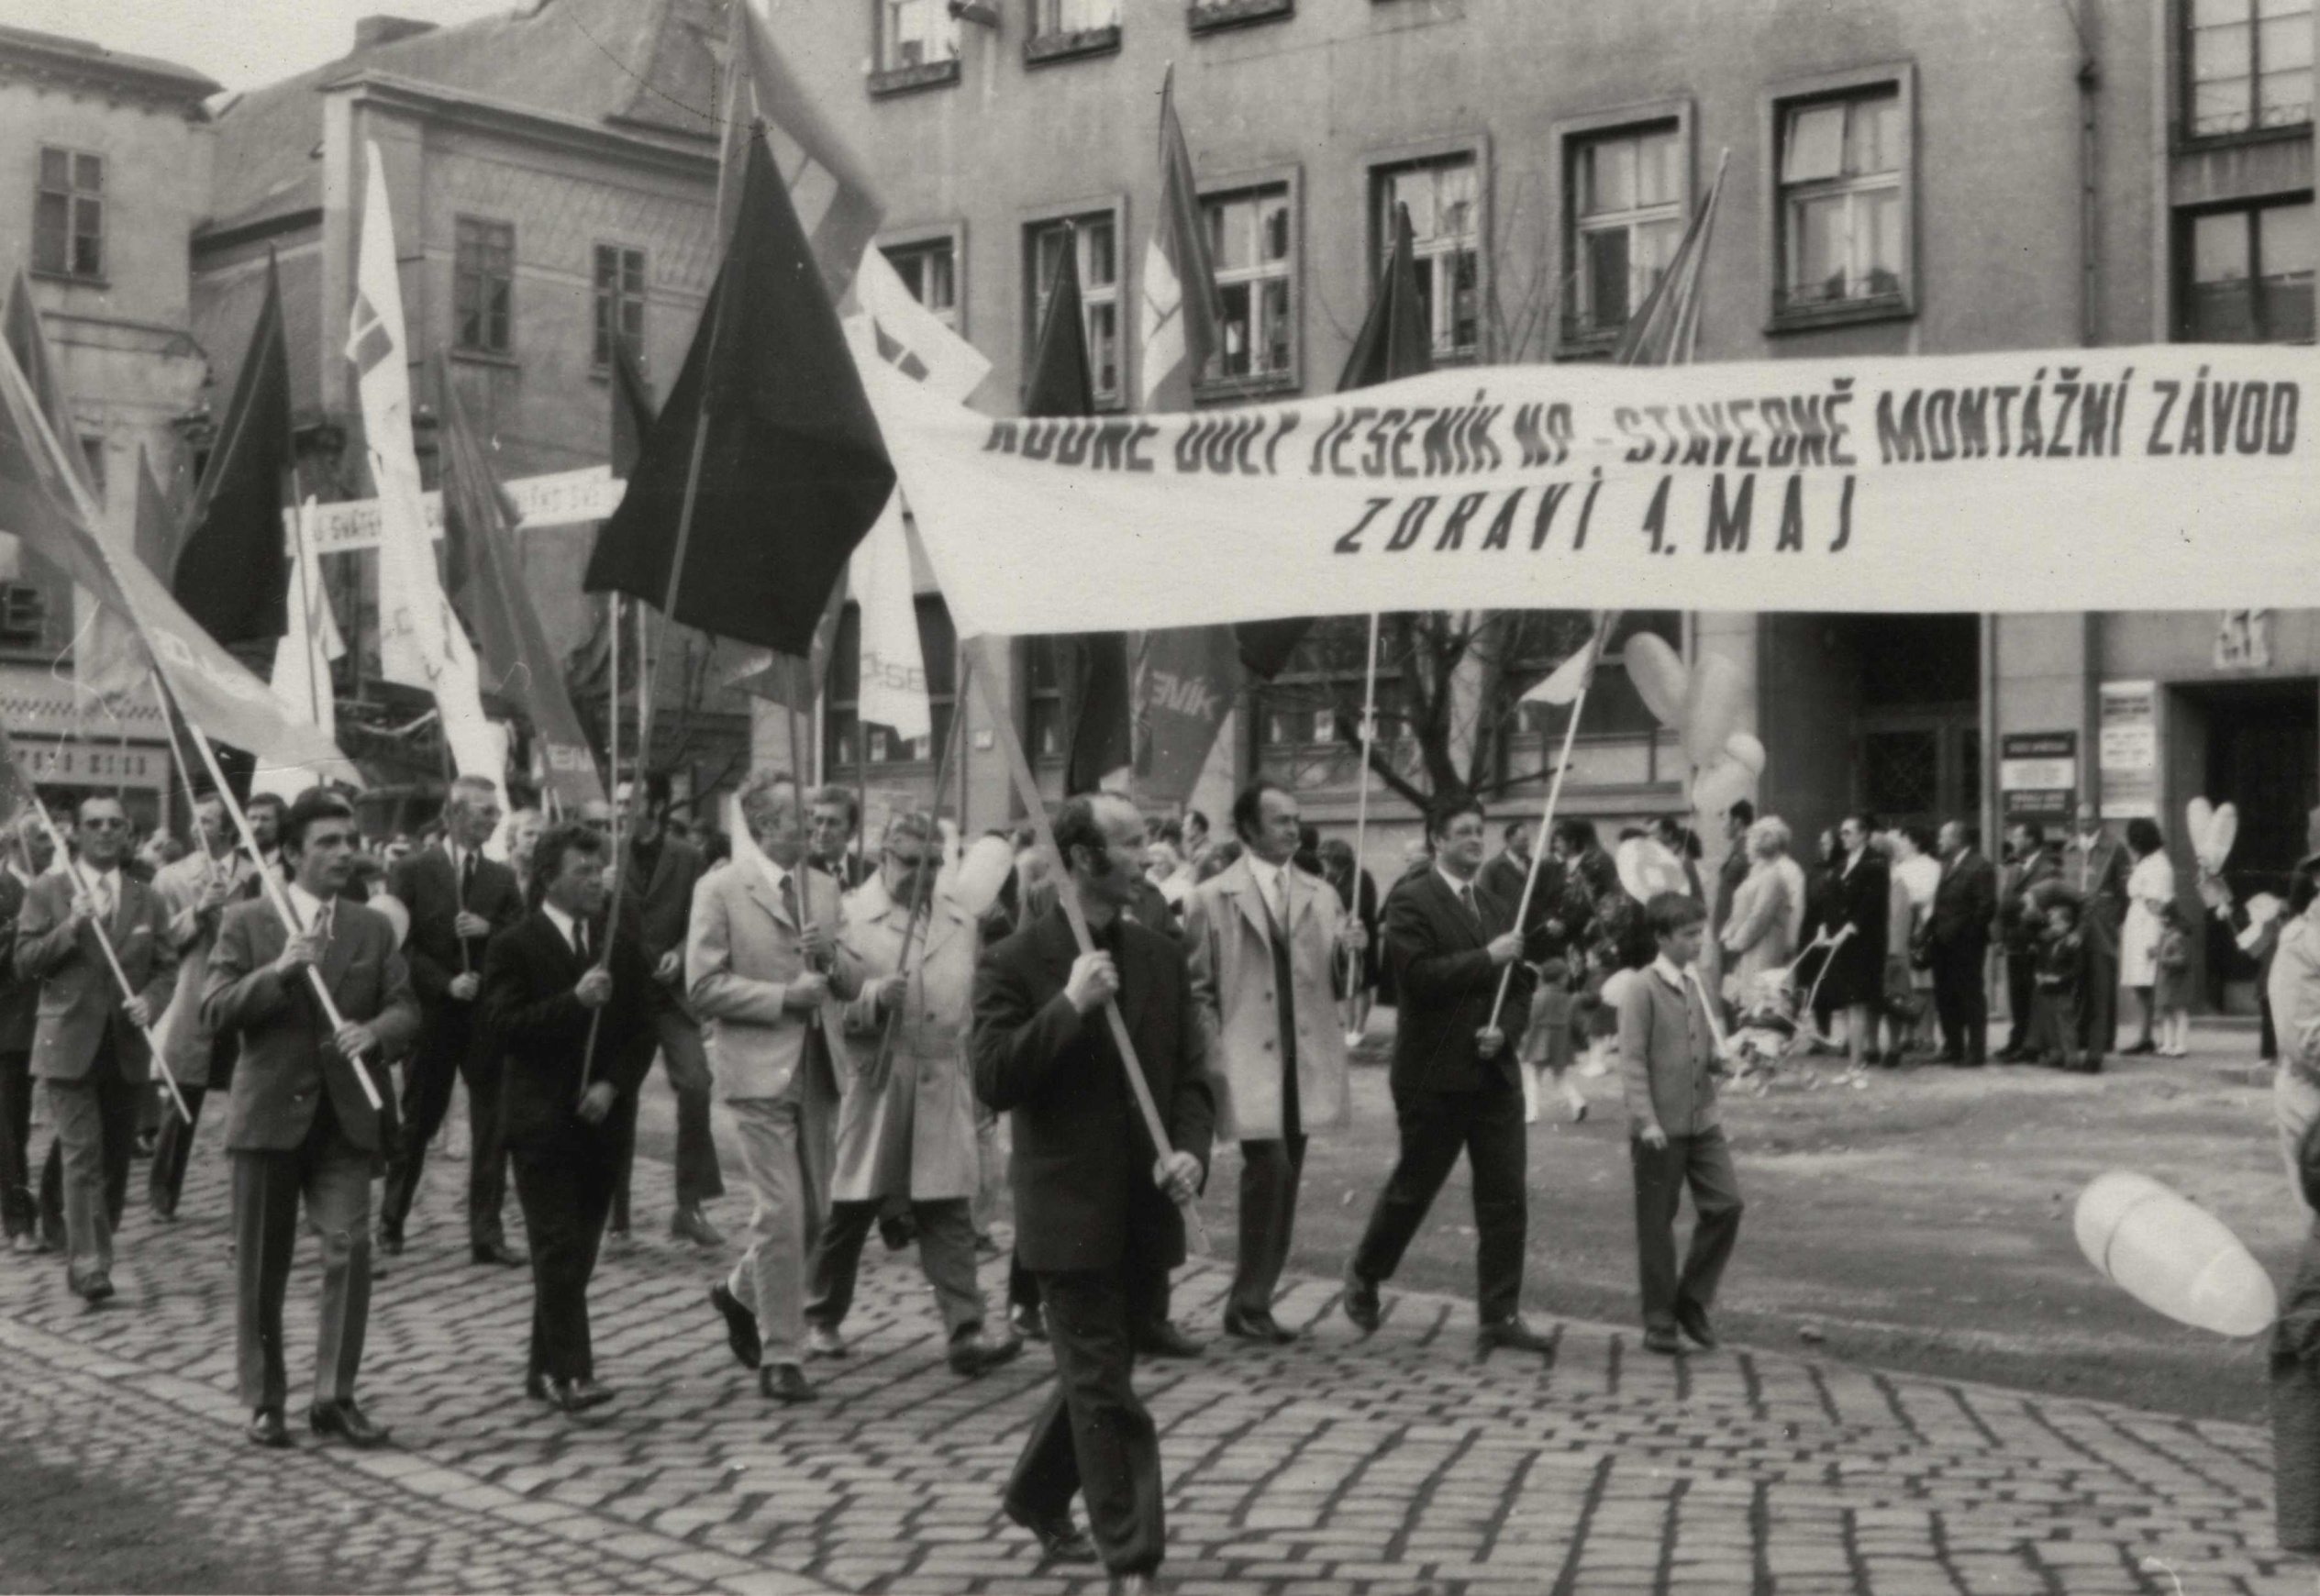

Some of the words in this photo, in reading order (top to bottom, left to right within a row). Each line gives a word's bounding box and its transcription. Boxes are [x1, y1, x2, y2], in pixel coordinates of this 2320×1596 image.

[1309, 387, 1504, 478] JESENÍK
[1876, 367, 2133, 462] MONTÁŽNÍ
[2147, 365, 2301, 457] ZÁVOD
[1334, 465, 1604, 553] ZDRAVÍ
[1641, 474, 1677, 555] 1.
